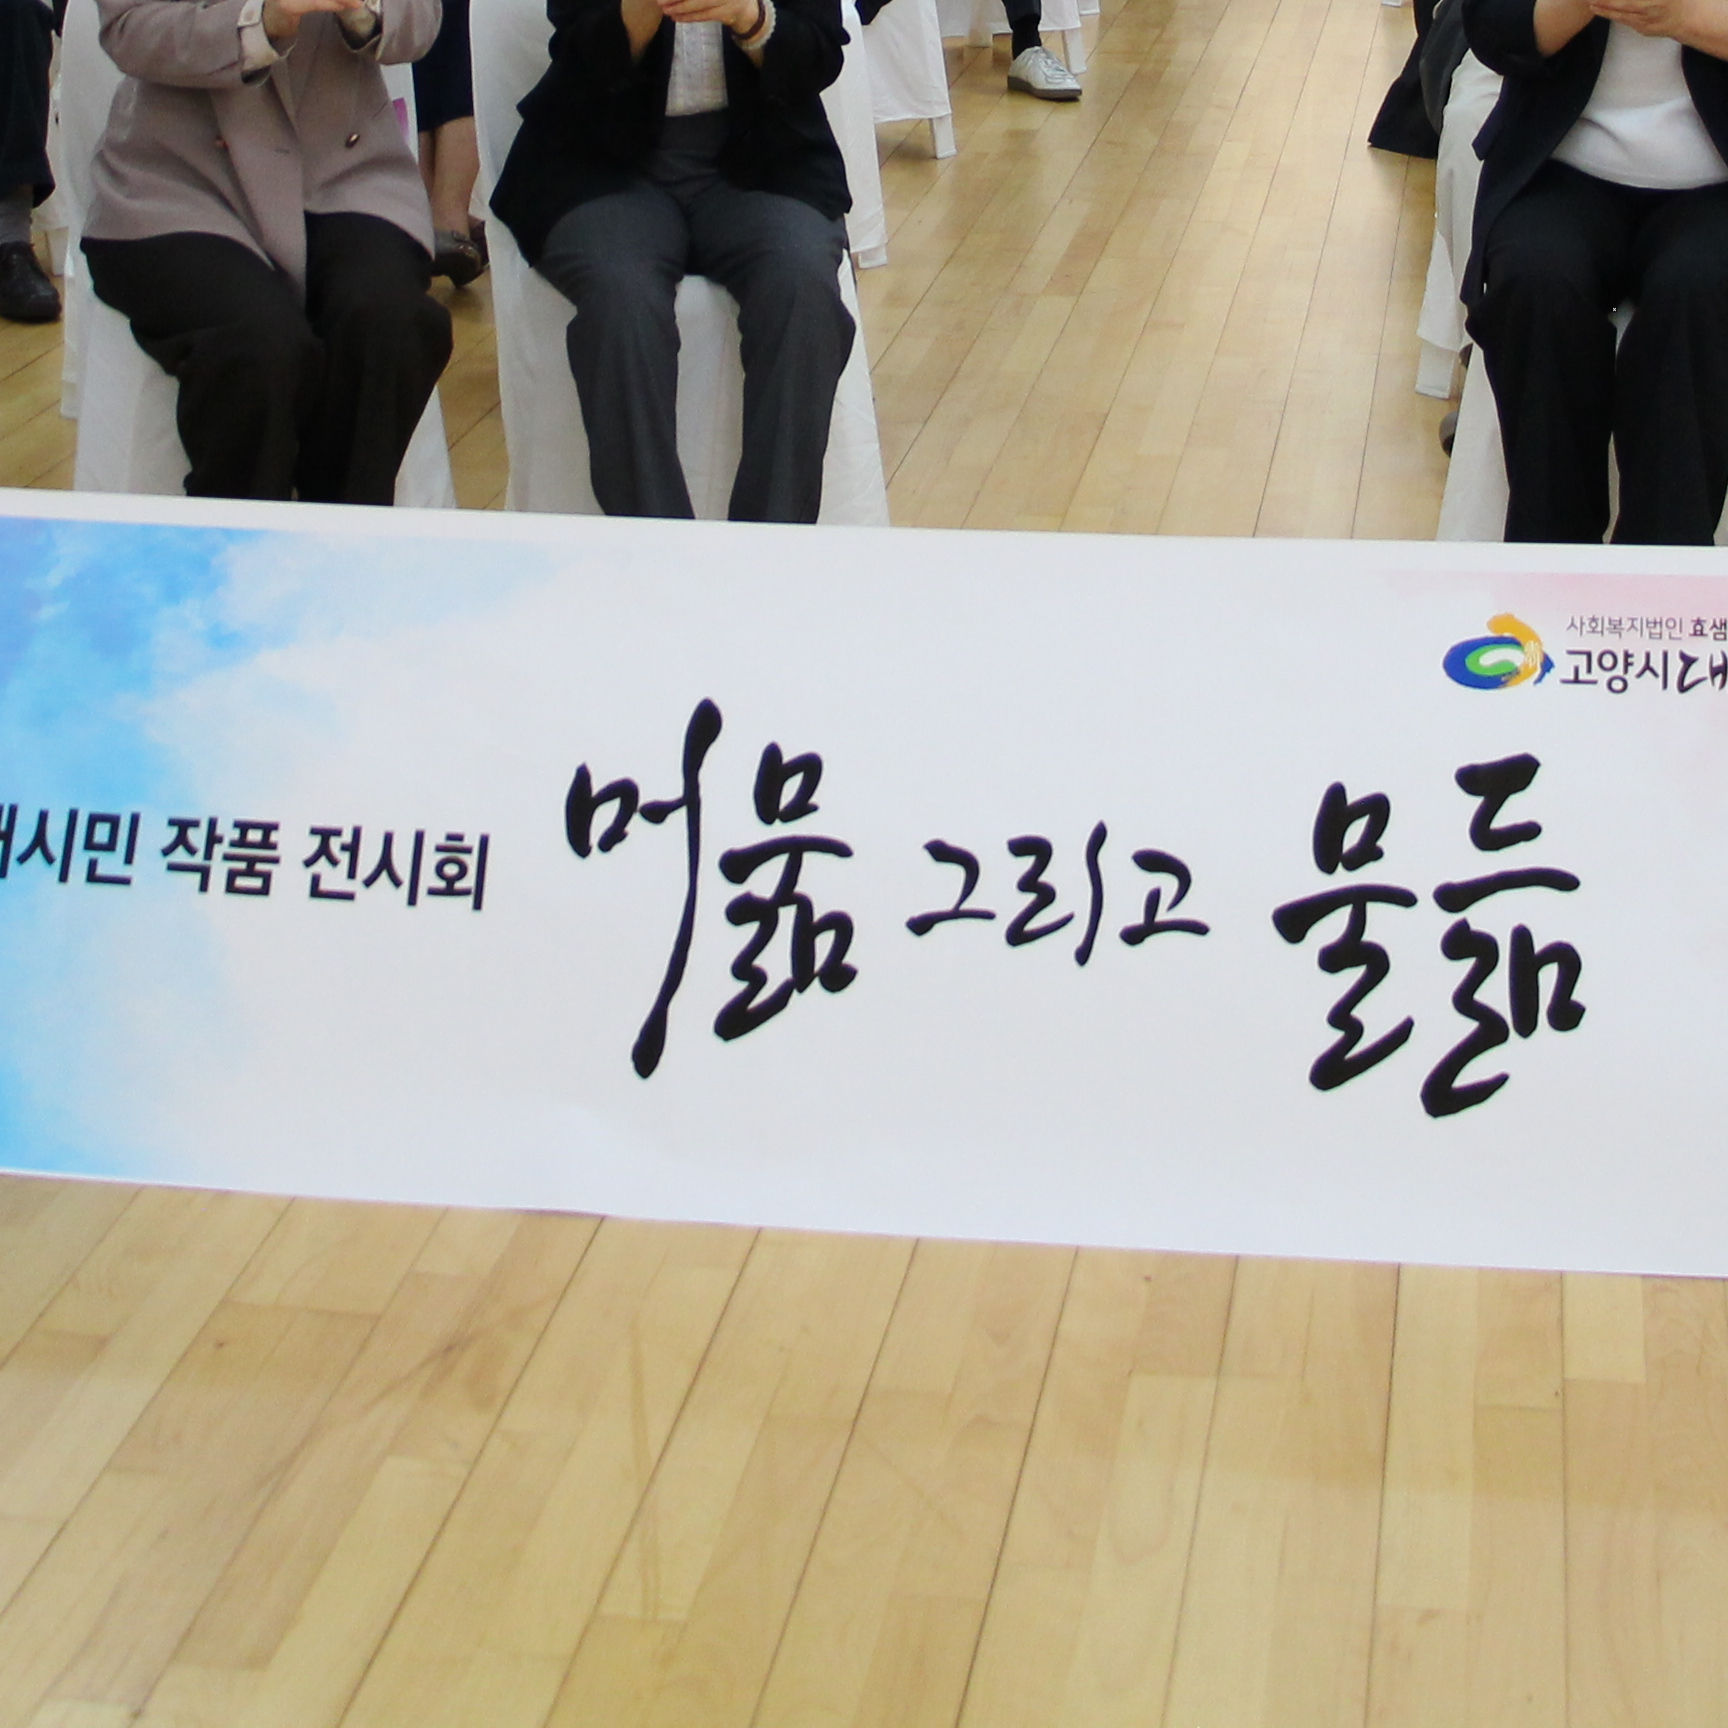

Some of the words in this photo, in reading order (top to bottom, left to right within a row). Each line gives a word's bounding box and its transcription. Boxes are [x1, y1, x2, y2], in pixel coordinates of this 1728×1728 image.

[1565, 615, 1684, 640] 사회복지법인
[1688, 616, 1728, 640] 효샘
[161, 816, 282, 897] 작품
[302, 823, 491, 912] 전시회
[564, 696, 859, 1079] 머묾
[905, 820, 1211, 967] 그리고
[1270, 752, 1586, 1118] 물듦
